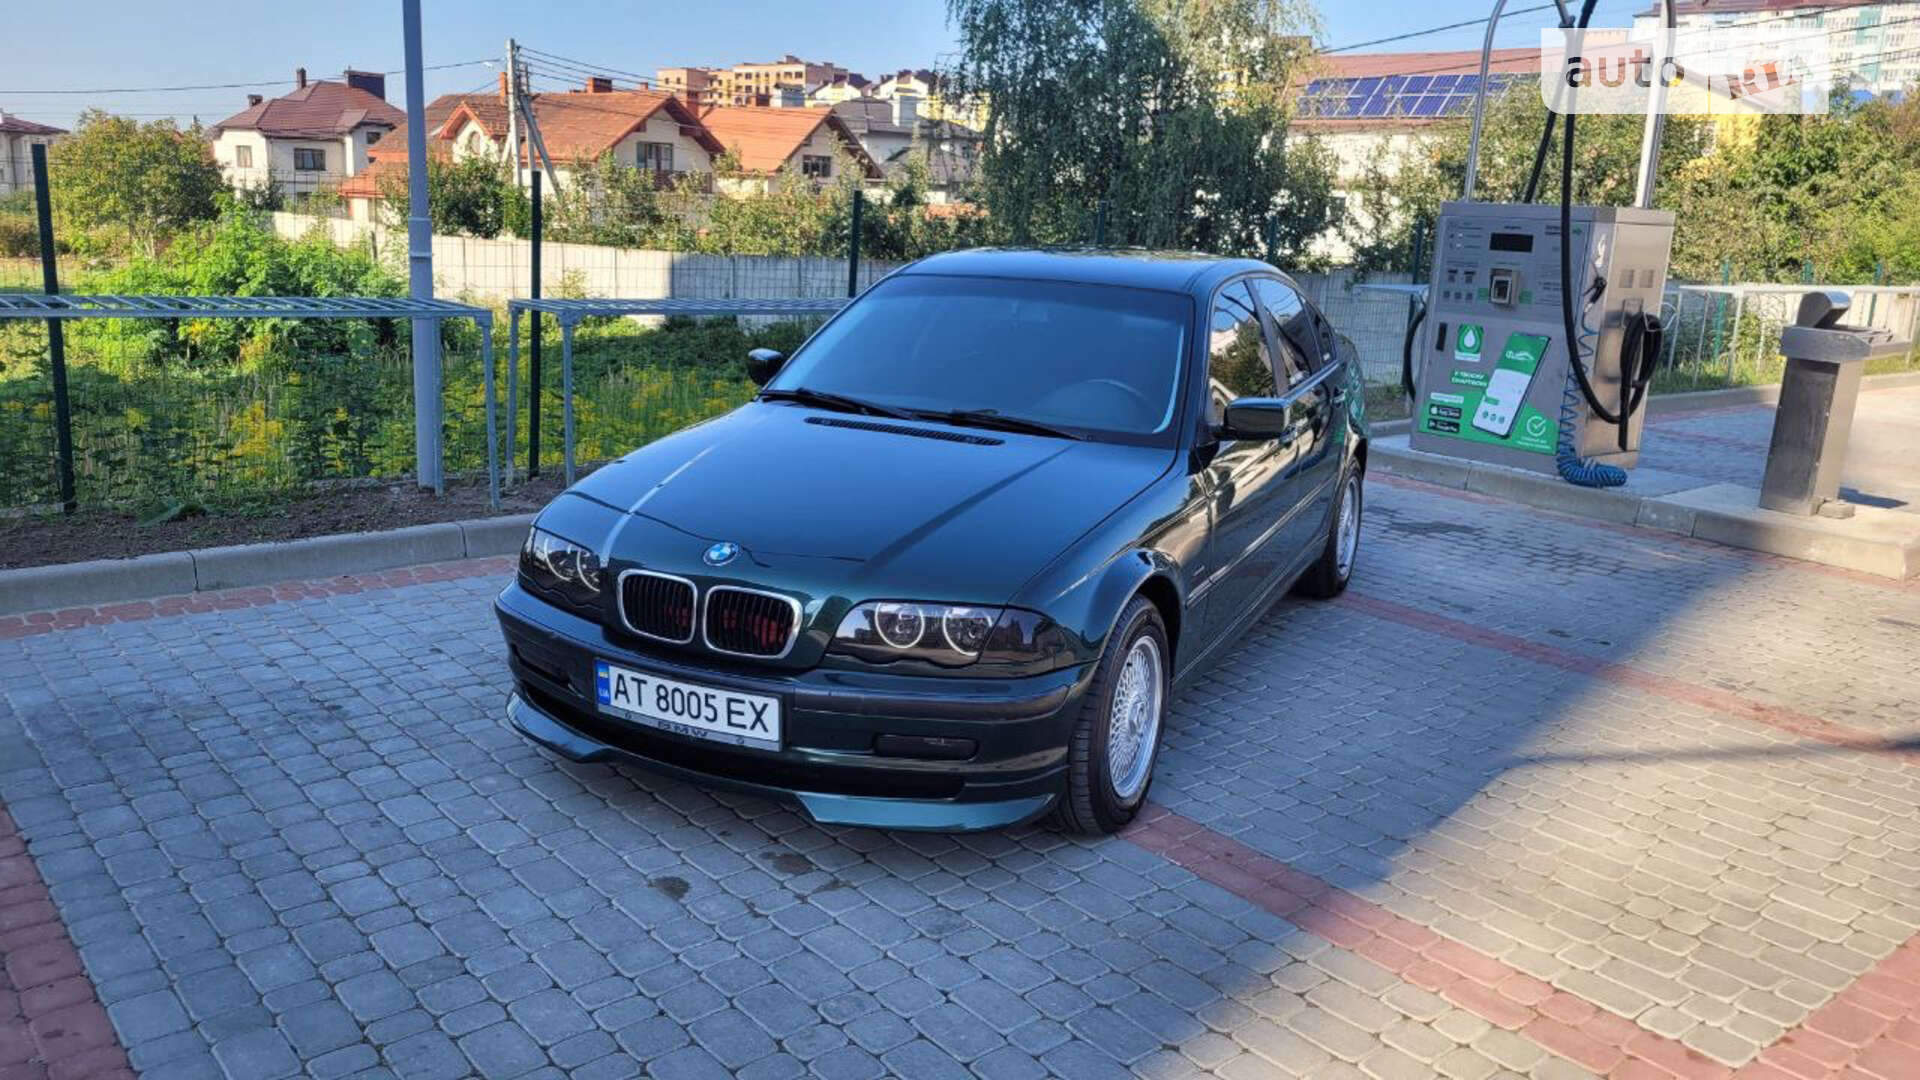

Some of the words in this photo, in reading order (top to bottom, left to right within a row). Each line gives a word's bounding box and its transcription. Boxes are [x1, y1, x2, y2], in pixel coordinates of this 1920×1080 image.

[614, 673, 647, 707] AT
[656, 684, 718, 723] 8005
[726, 697, 769, 733] EX
